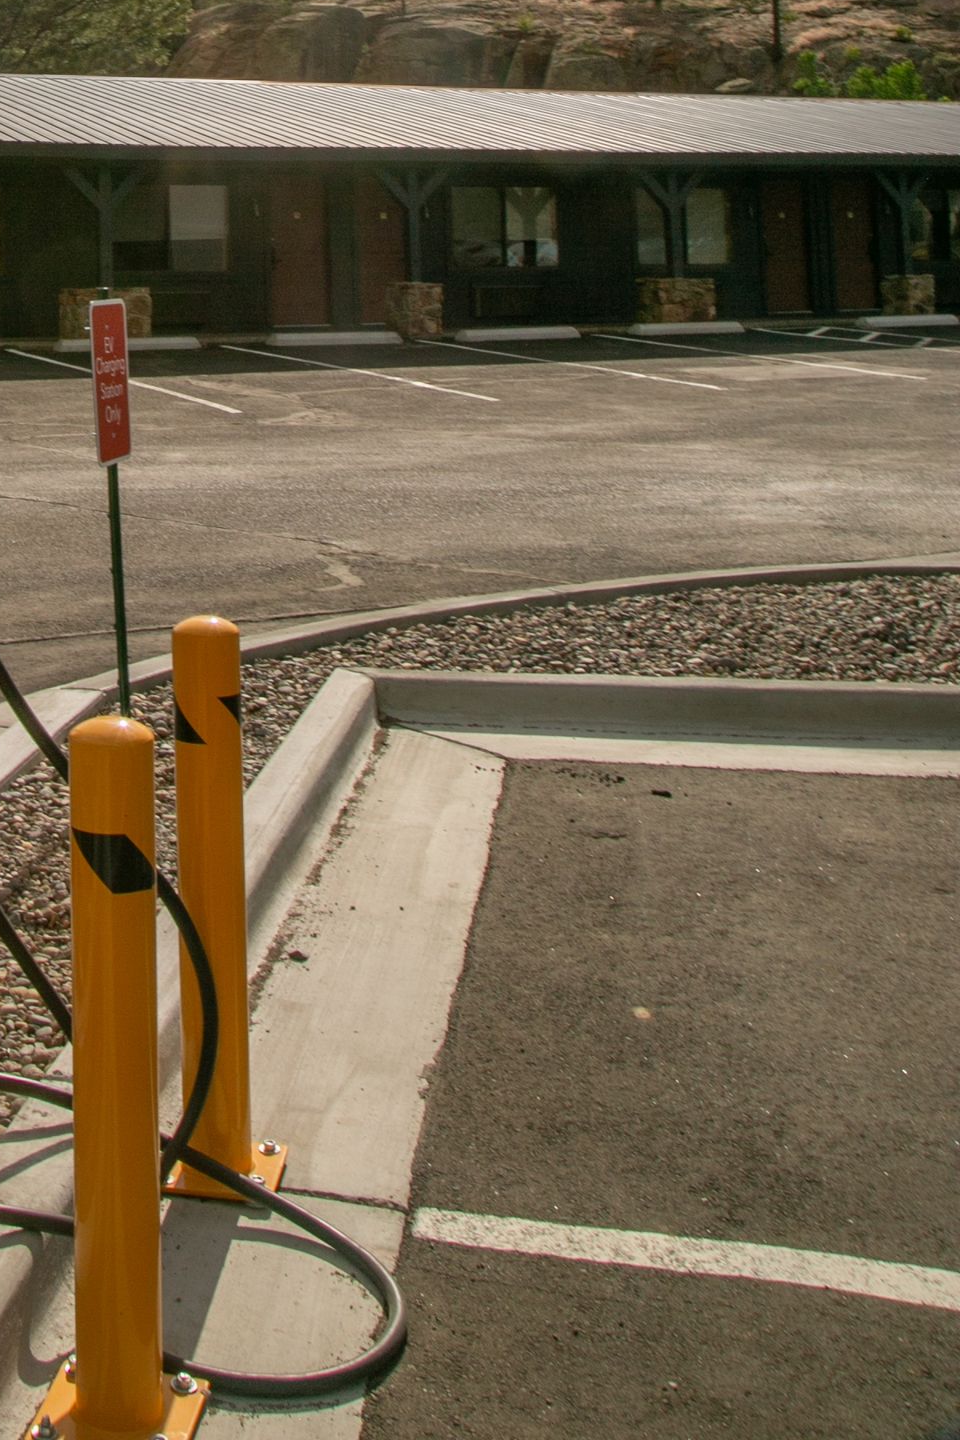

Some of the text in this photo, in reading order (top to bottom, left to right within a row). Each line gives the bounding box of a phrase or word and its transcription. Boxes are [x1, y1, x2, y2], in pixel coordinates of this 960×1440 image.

[95, 356, 125, 376] Charging
[101, 382, 123, 399] Station
[106, 404, 121, 424] Only
